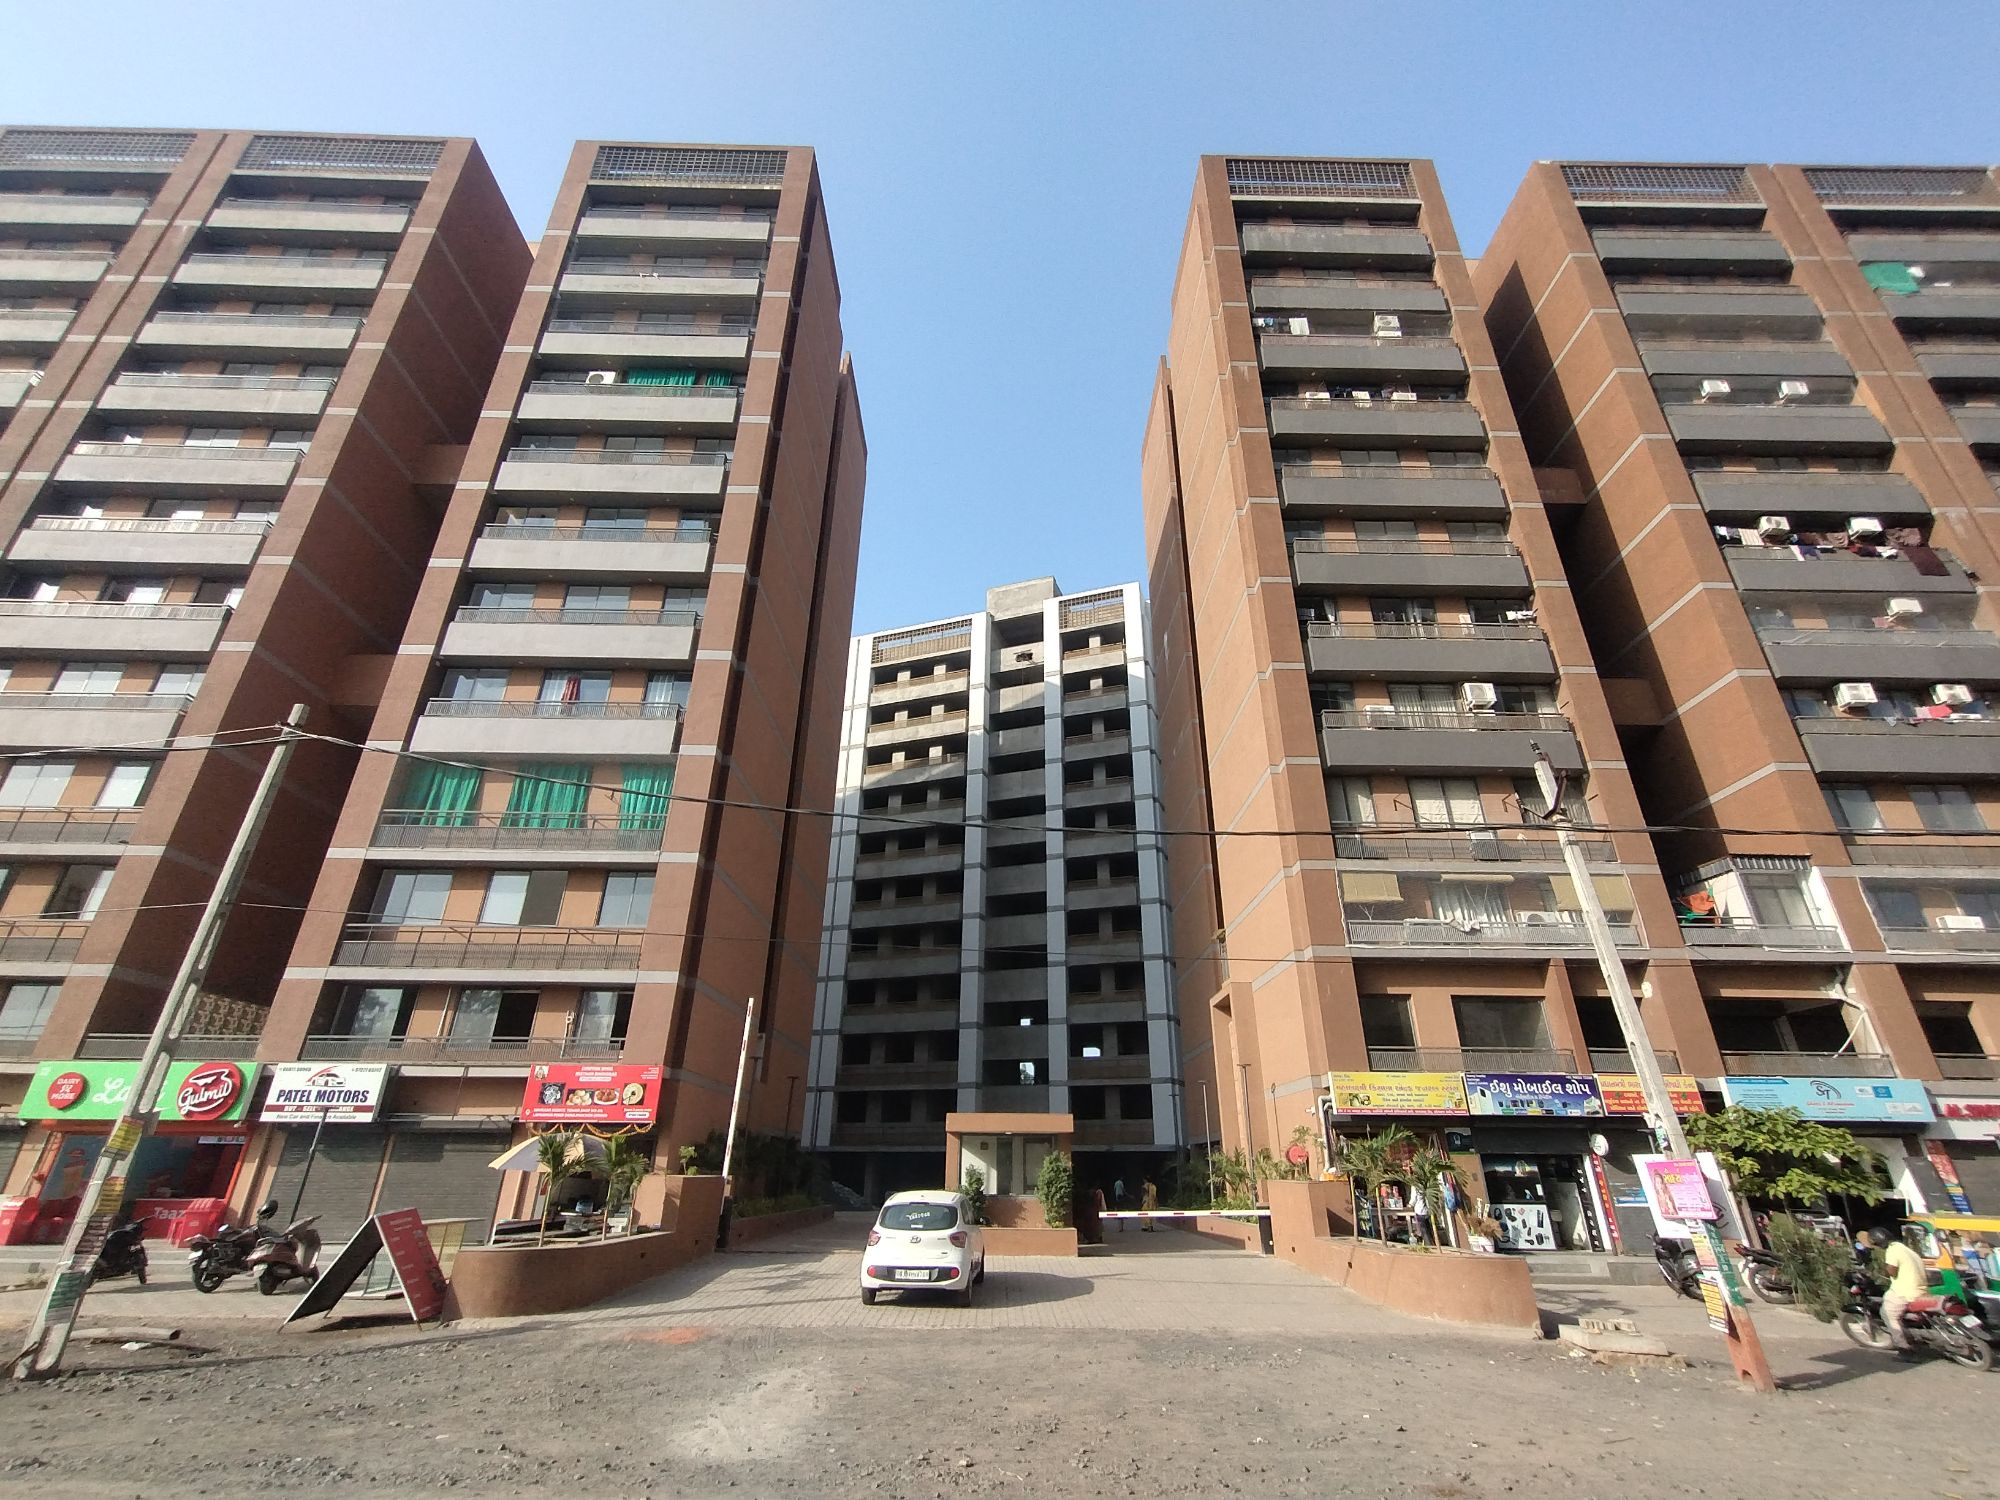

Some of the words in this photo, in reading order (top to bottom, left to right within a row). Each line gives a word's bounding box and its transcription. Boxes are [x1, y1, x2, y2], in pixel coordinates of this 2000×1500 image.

[1489, 1079, 1512, 1098] ઈશુ
[1513, 1078, 1564, 1095] મોબાઈલ
[1565, 1079, 1592, 1095] શોપ
[51, 1092, 76, 1100] MORE
[276, 1089, 312, 1103] PATEL
[314, 1089, 370, 1103] MOTORS
